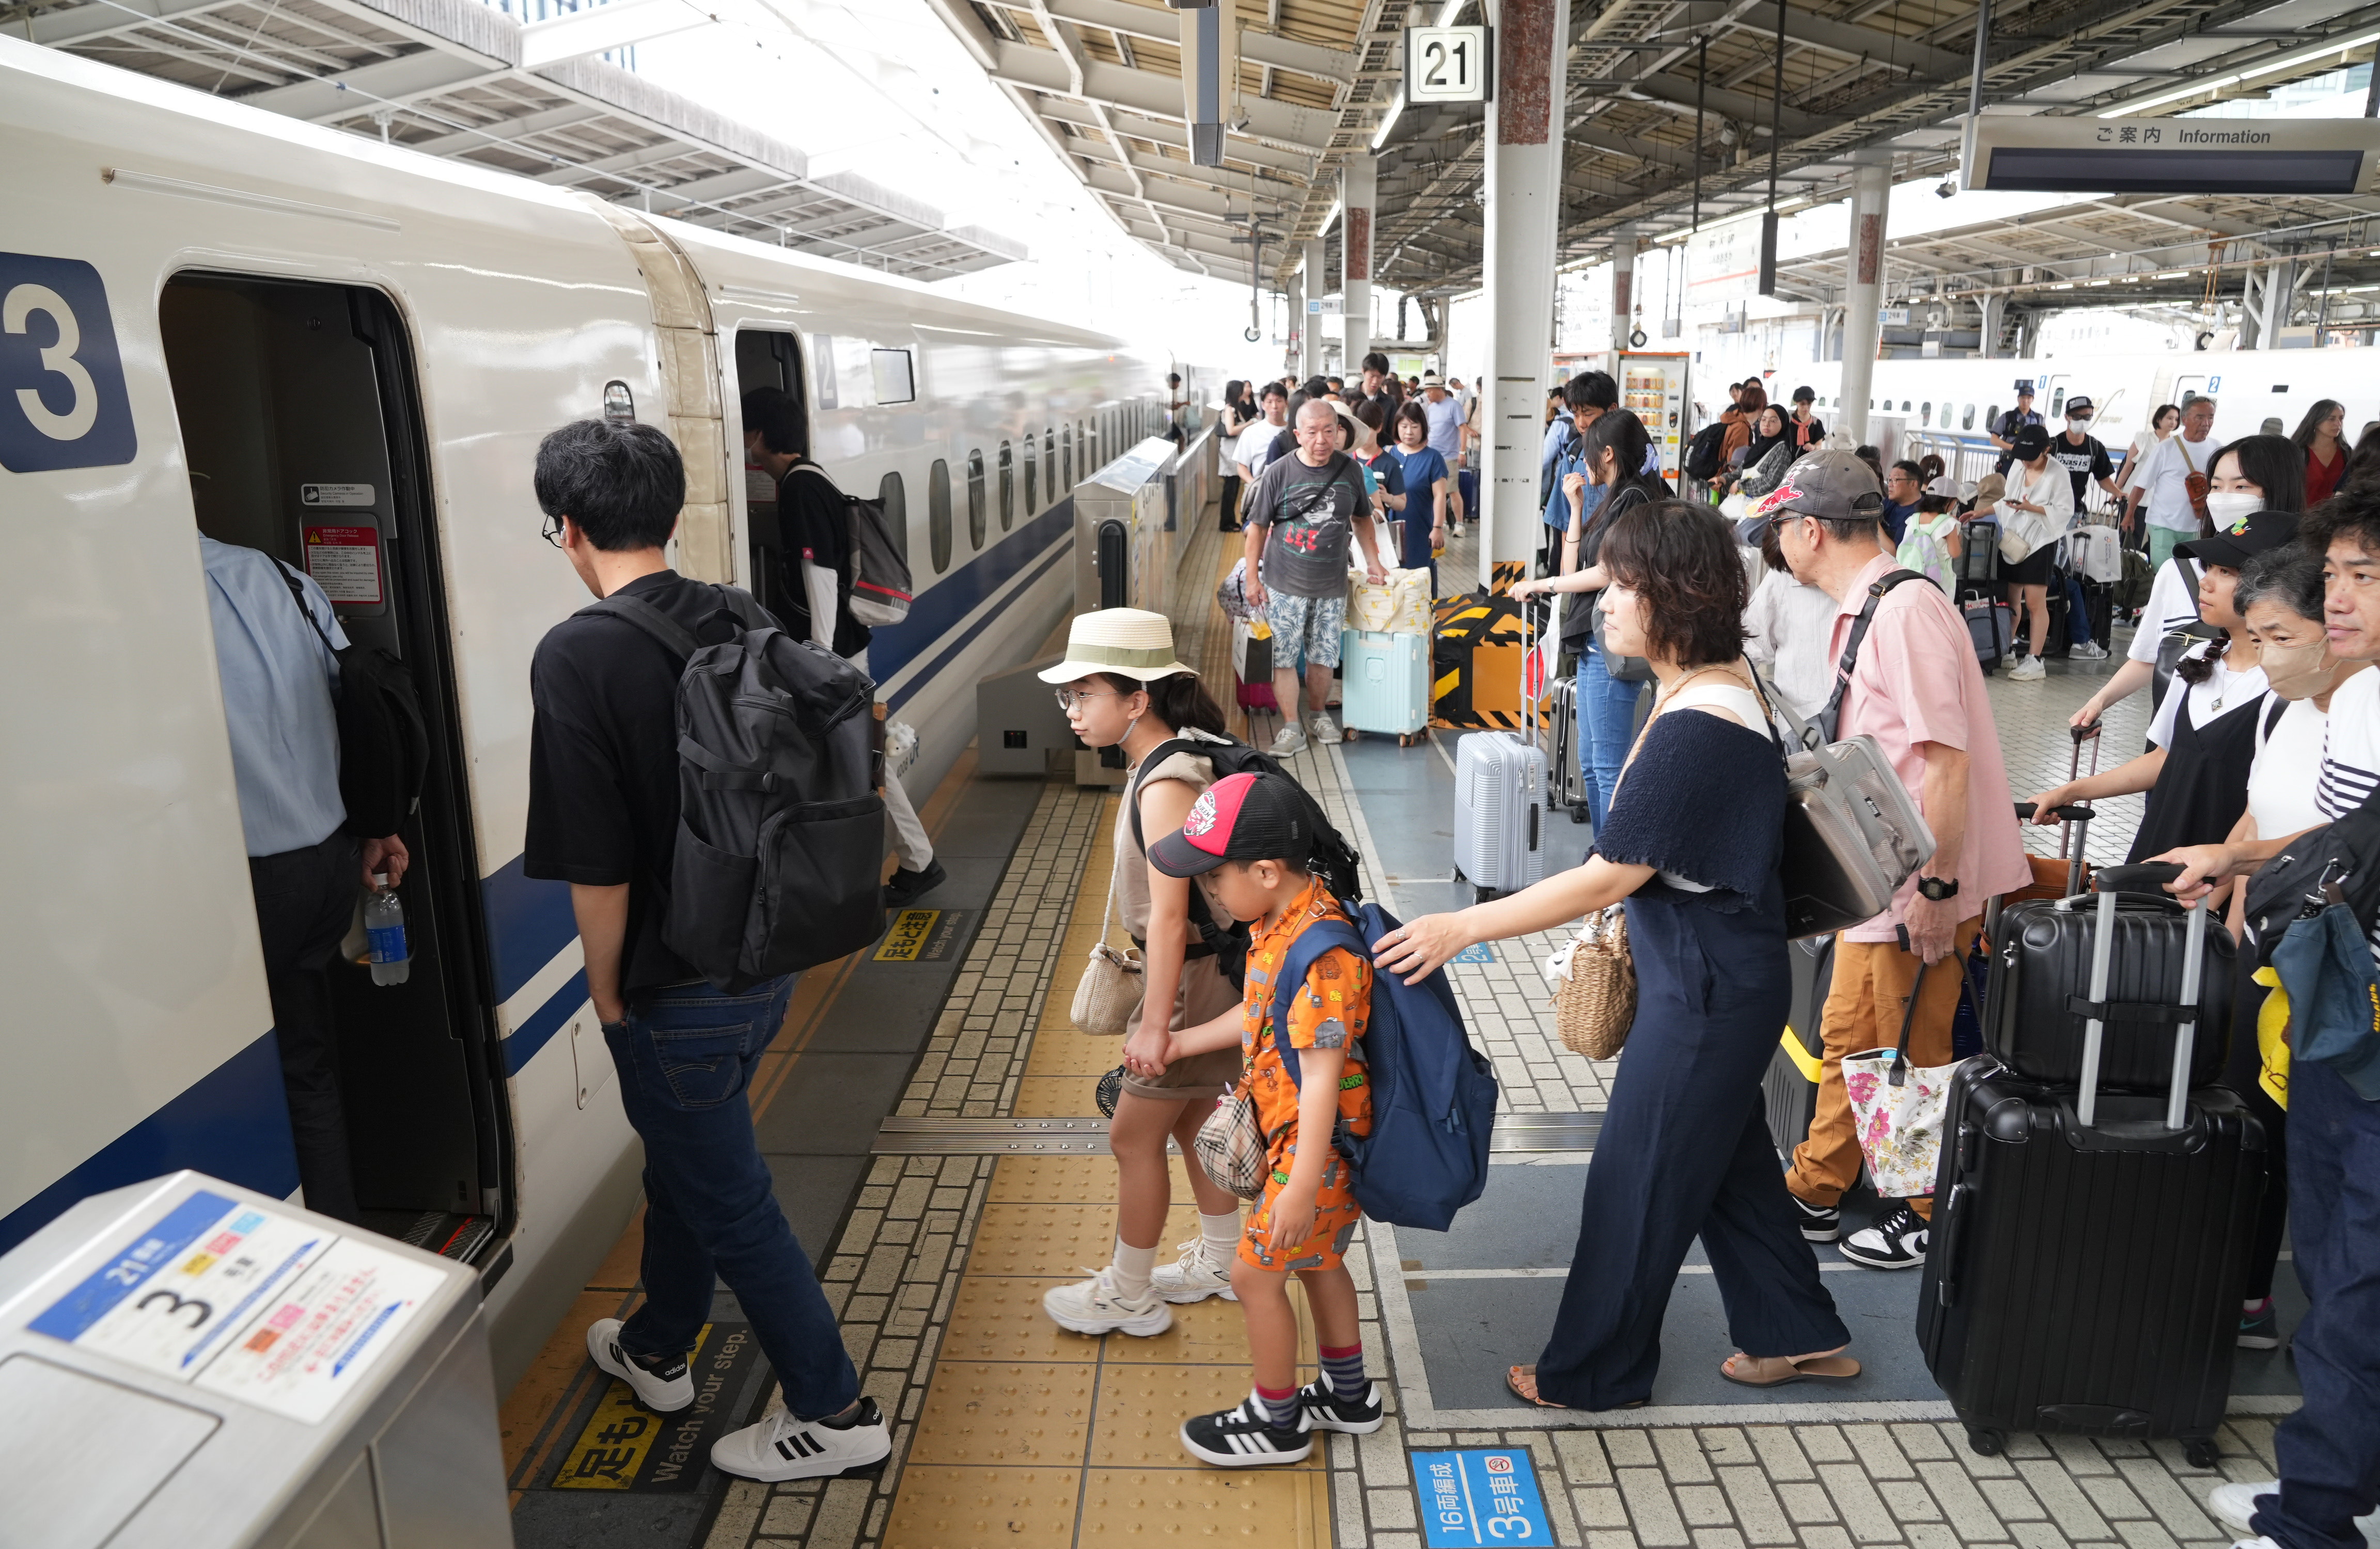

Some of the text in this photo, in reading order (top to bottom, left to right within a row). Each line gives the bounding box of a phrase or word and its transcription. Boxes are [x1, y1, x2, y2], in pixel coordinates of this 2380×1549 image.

[1424, 40, 1466, 86] 21
[2097, 127, 2271, 144] ご案内 Information
[4, 282, 99, 441] 3
[819, 344, 834, 400] 2
[2209, 377, 2219, 392] 2
[883, 912, 933, 958] 足もと注意
[925, 911, 963, 959] Watch your step.
[137, 1288, 213, 1329] 3
[665, 1363, 686, 1376] adidas
[651, 1329, 747, 1483] Watch your step.
[1429, 1462, 1466, 1533] 16両編成
[1487, 1475, 1532, 1539] 3号車
